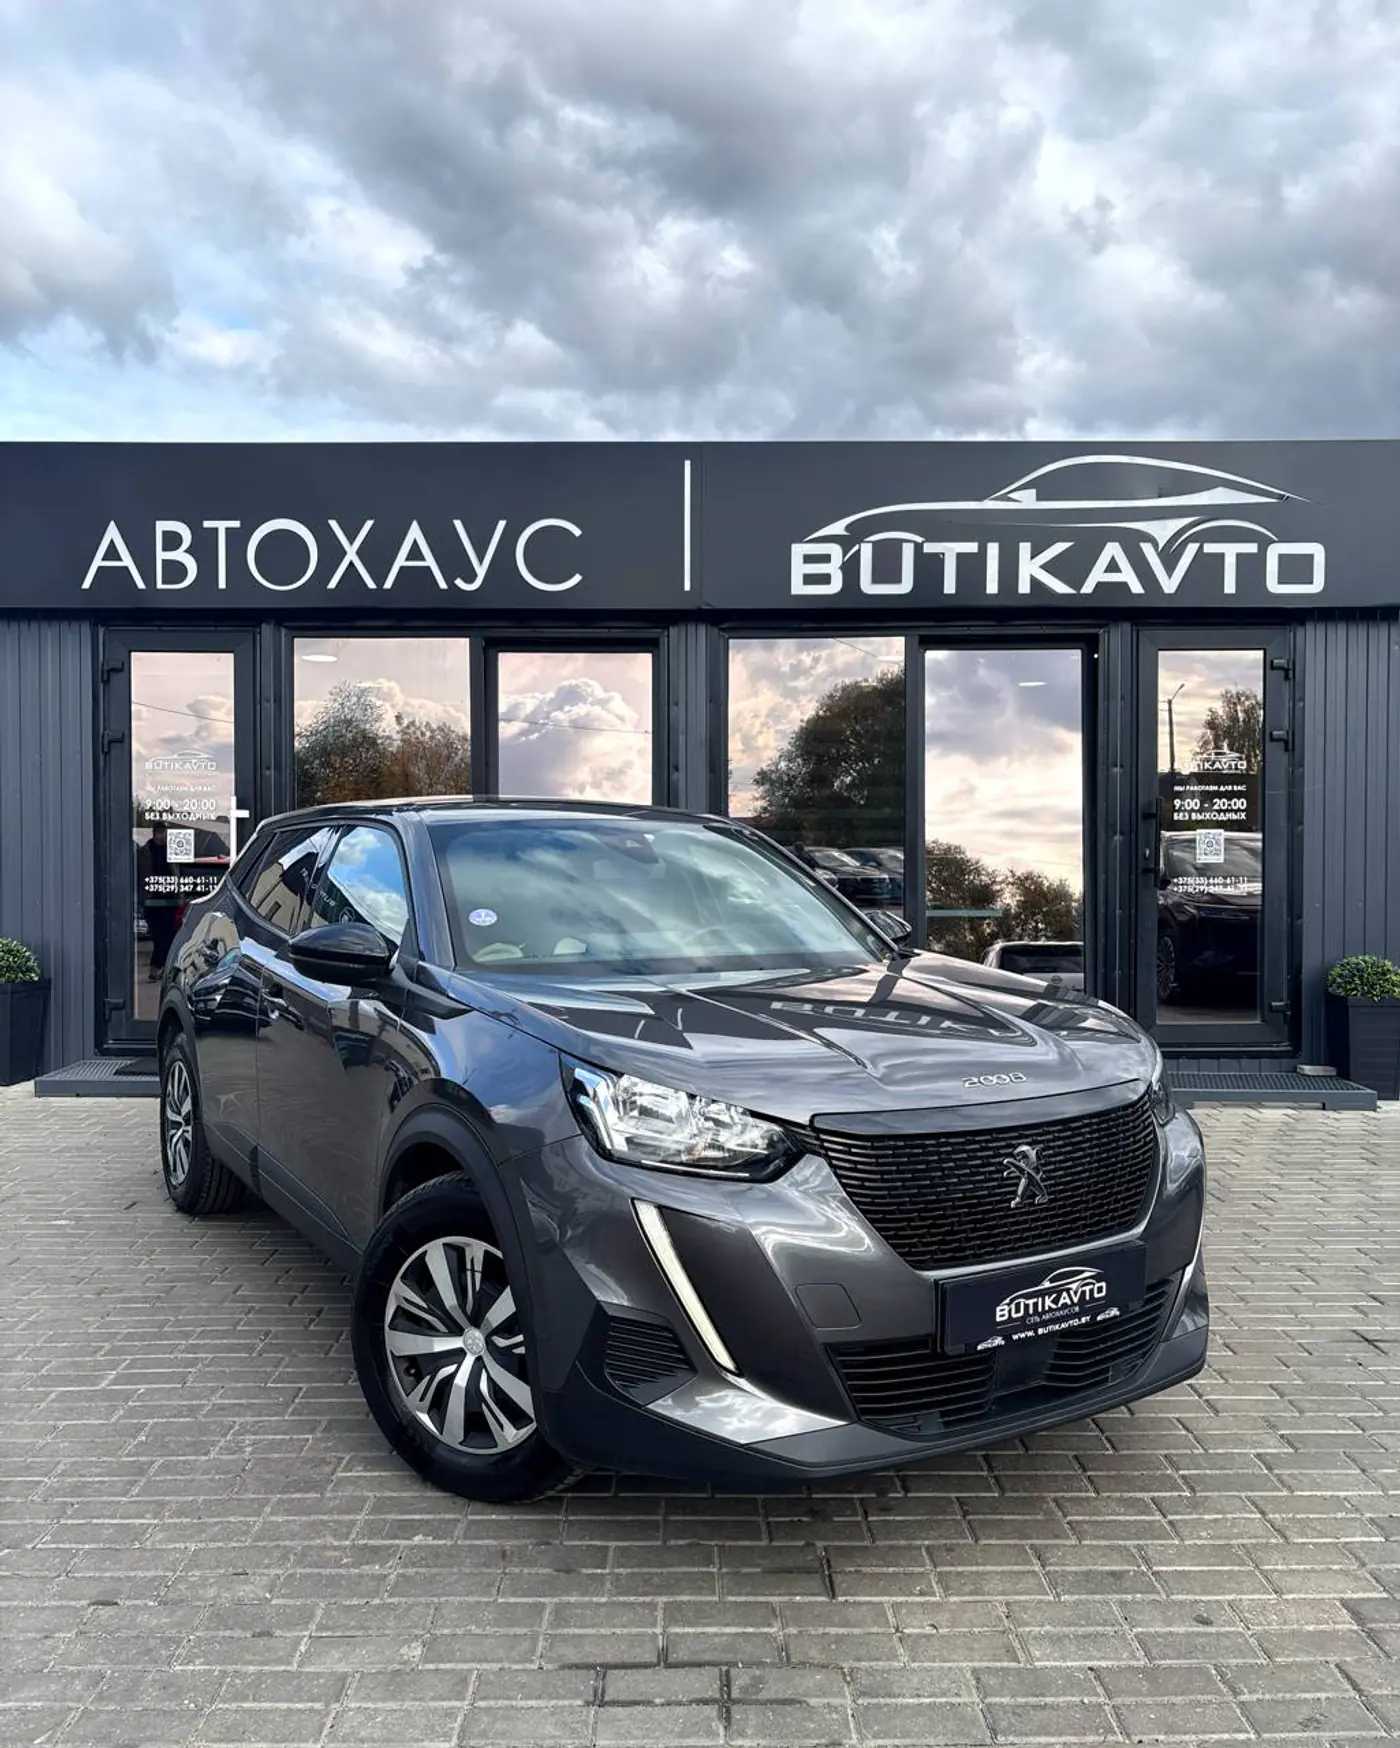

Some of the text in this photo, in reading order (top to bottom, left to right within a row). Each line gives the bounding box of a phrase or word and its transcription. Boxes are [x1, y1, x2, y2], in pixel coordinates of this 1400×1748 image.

[82, 518, 582, 592] АВТОХАУС
[791, 541, 1325, 595] BUTIKAVTO
[183, 799, 216, 810] 20:00
[1174, 798, 1200, 810] 9:00
[1212, 798, 1247, 810] 20:00
[1174, 812, 1247, 820] БЕЗ ВЫХОДНЫХ
[961, 1072, 1027, 1088] 2008
[995, 1282, 1106, 1322] BUTIKAVTO
